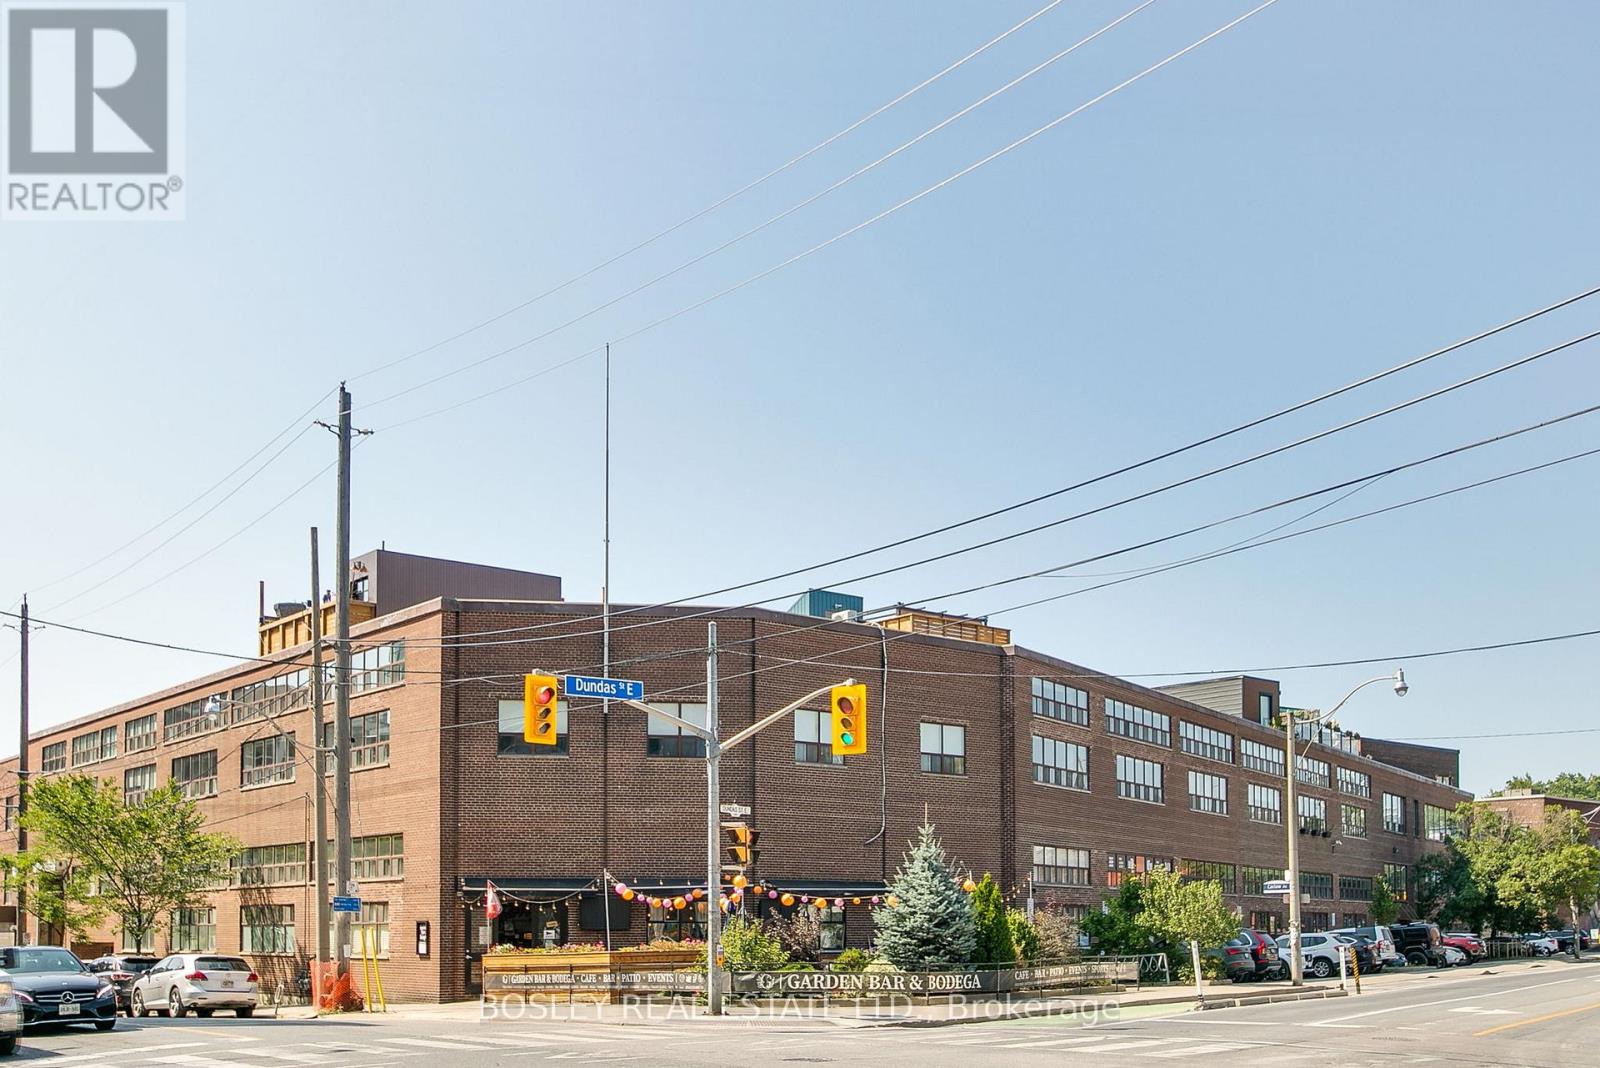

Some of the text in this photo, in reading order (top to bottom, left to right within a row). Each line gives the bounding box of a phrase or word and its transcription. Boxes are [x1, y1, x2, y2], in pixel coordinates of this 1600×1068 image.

[576, 678, 633, 695] Dundas St E
[511, 974, 534, 984] GARDEN
[534, 974, 547, 984] BAR
[546, 974, 552, 984] &
[552, 973, 576, 984] BODEGA
[580, 973, 597, 983] CAFE
[603, 973, 616, 983] BAR
[621, 973, 641, 983] PATIO
[647, 973, 674, 983] EVENTS
[1014, 970, 1030, 980] CAFE
[1034, 968, 1046, 978] BAR
[1049, 966, 1065, 977] PATIO
[787, 974, 864, 990] GARDEN
[868, 975, 906, 990] BAR
[909, 974, 923, 990] &
[927, 974, 982, 990] BODEGA
